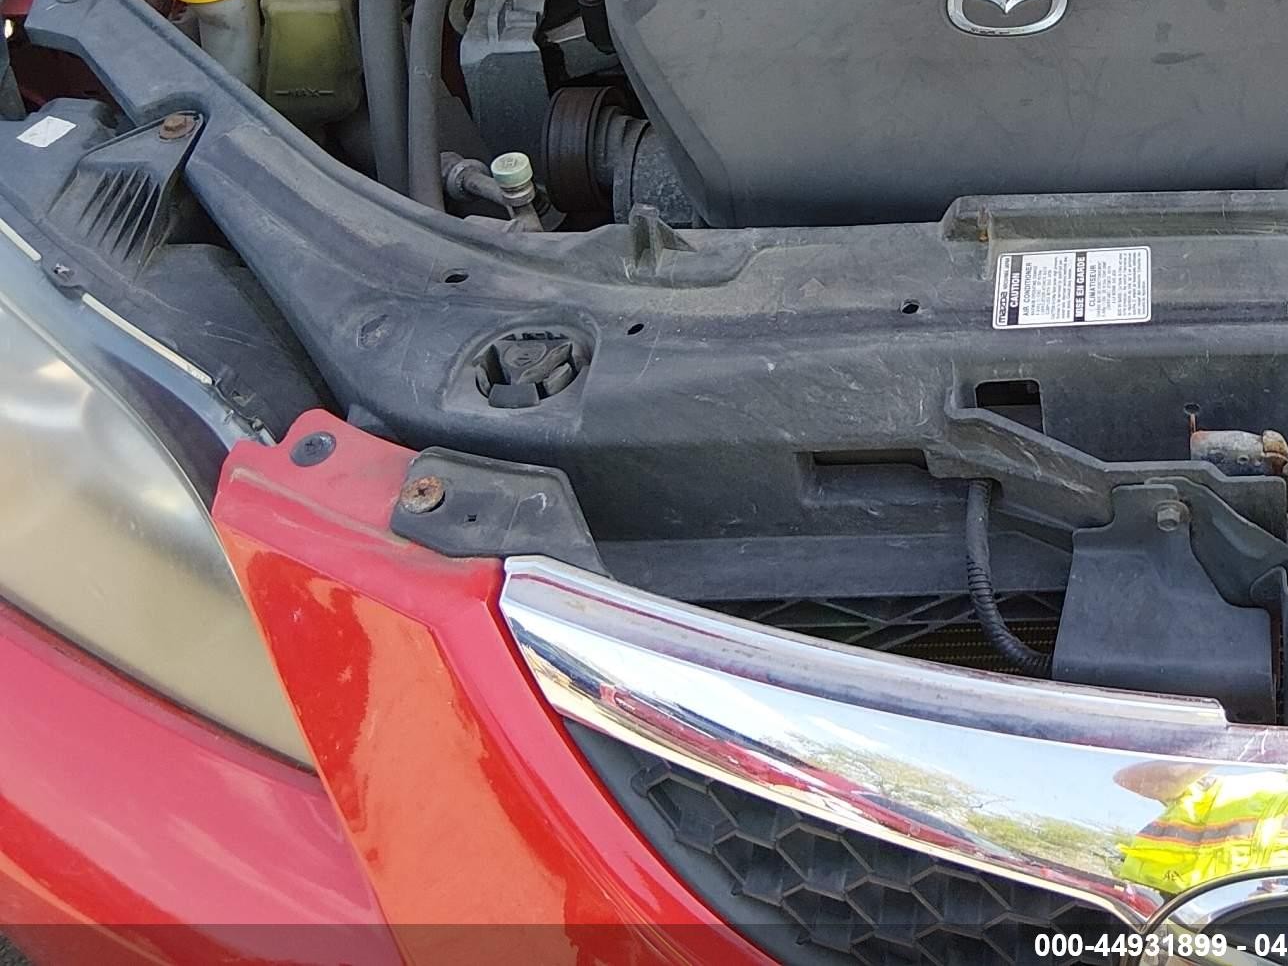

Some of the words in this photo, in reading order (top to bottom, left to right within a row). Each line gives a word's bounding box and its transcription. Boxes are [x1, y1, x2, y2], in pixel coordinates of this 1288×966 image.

[1023, 262, 1033, 302] CONDITIONER
[1075, 255, 1087, 285] GARDE
[1009, 272, 1021, 308] CAUTION
[1075, 285, 1086, 297] EN
[1088, 264, 1097, 307] CLIMATISEUR
[1022, 303, 1031, 317] AIR
[1074, 297, 1086, 318] MISE
